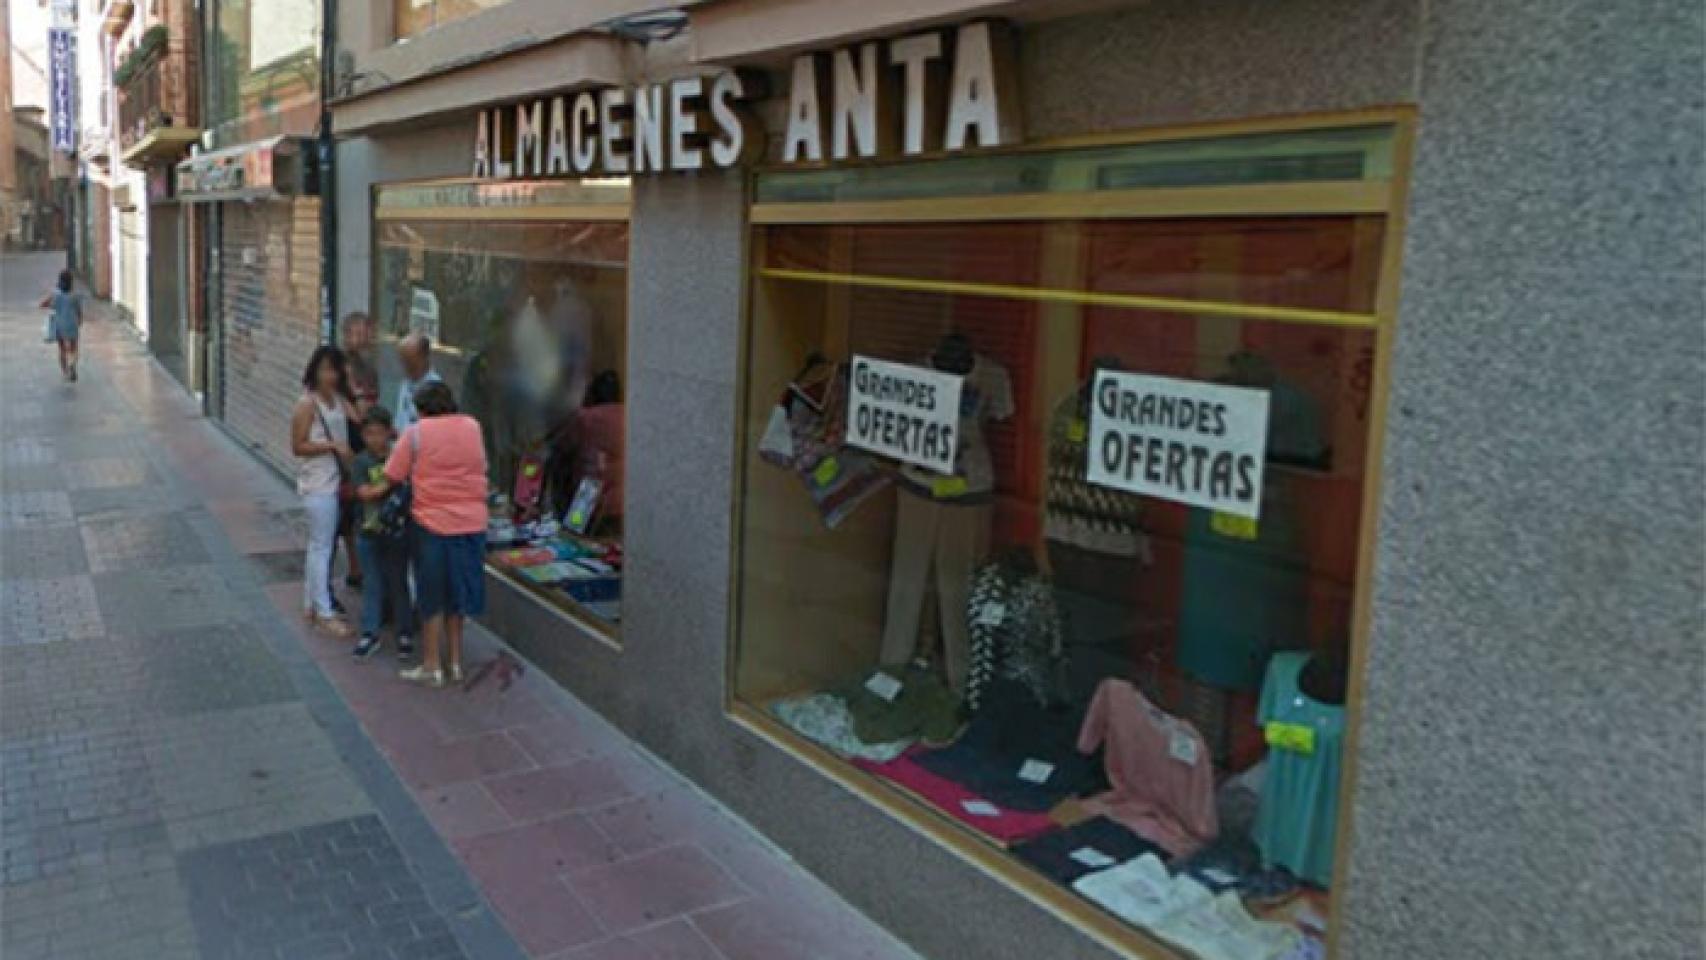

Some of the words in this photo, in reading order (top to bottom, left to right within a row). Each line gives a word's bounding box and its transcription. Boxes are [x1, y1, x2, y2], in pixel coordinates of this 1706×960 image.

[473, 69, 744, 178] ALMACENES
[784, 22, 999, 162] ANTA
[856, 361, 936, 411] GRANDES
[1099, 378, 1227, 436] GRANDES
[858, 402, 953, 463] OFERTAS
[1104, 431, 1256, 503] OFERTAS
